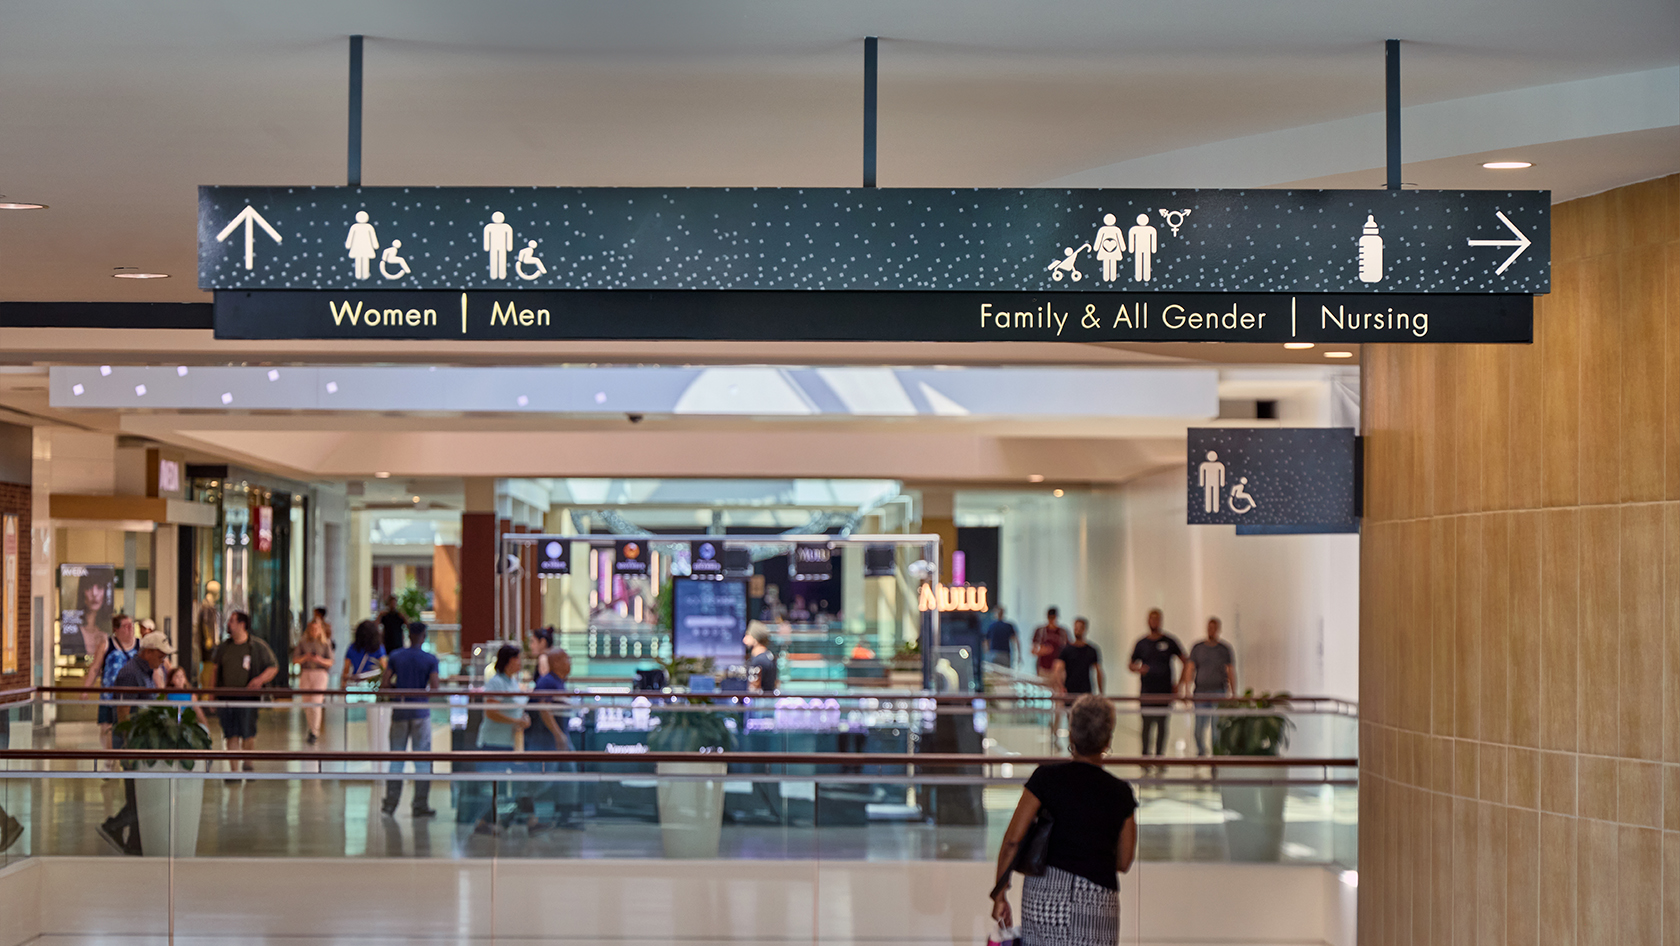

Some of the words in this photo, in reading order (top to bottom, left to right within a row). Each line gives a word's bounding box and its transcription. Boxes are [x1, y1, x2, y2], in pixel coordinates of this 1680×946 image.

[329, 300, 437, 327] Women
[489, 300, 551, 327] Men
[980, 301, 1069, 337] Family
[1080, 303, 1101, 329] &
[1112, 302, 1148, 329] All
[1161, 302, 1267, 330] Gender
[1321, 303, 1429, 338] Nursing
